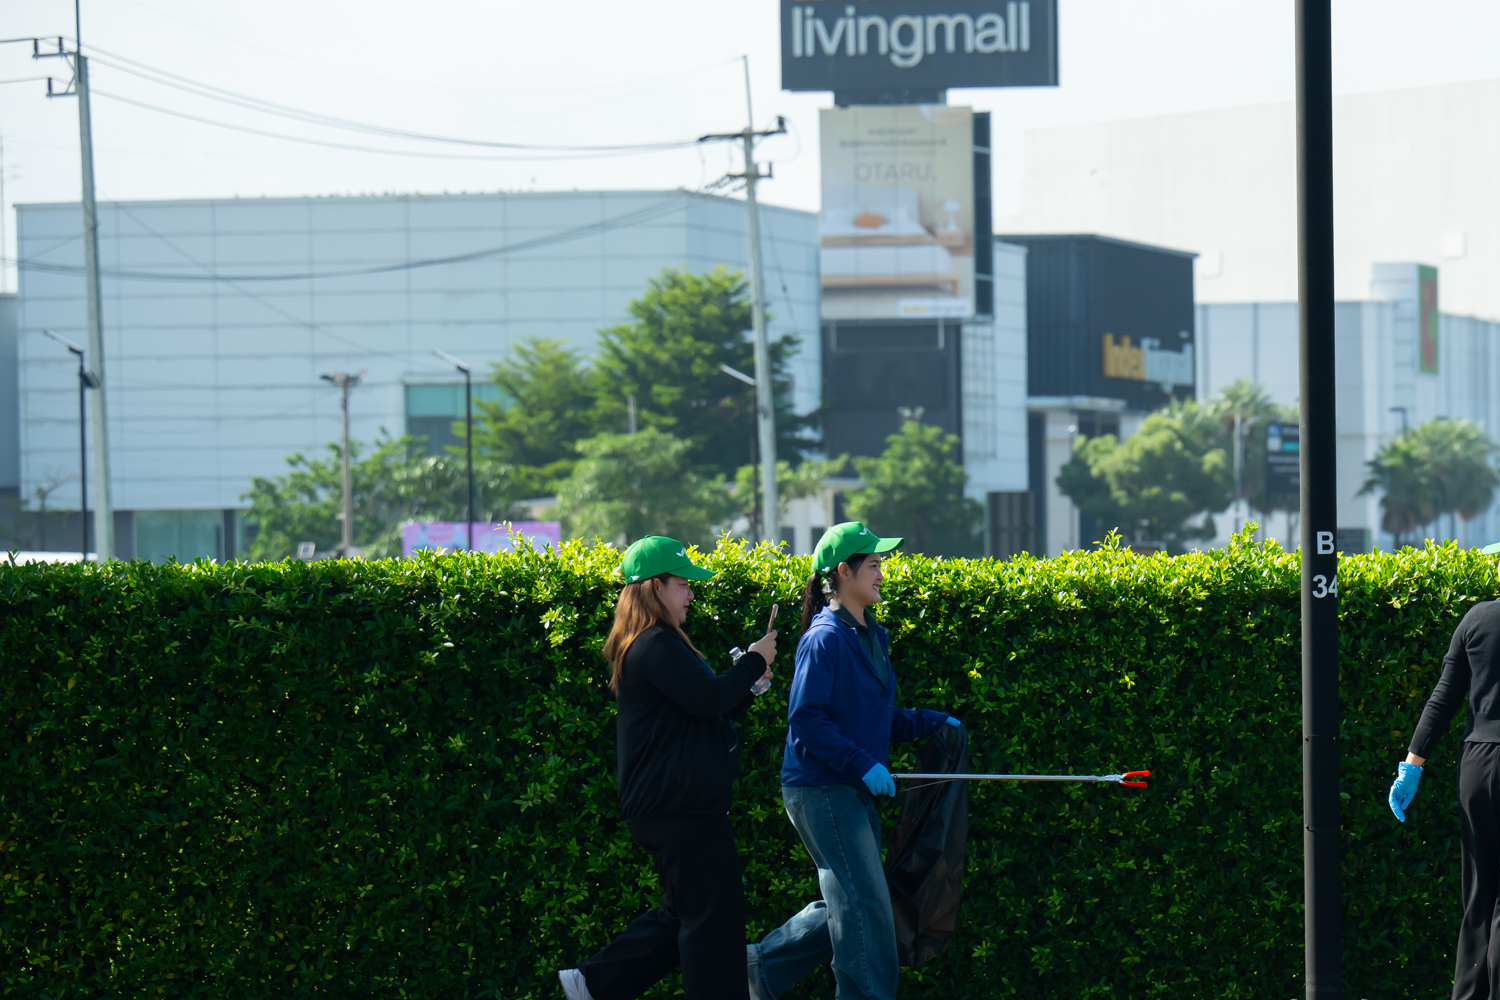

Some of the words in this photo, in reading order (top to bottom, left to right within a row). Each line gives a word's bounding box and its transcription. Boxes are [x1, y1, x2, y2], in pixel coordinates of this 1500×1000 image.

[792, 1, 1031, 68] livingmall
[1316, 530, 1335, 555] B
[1312, 573, 1338, 599] 34
